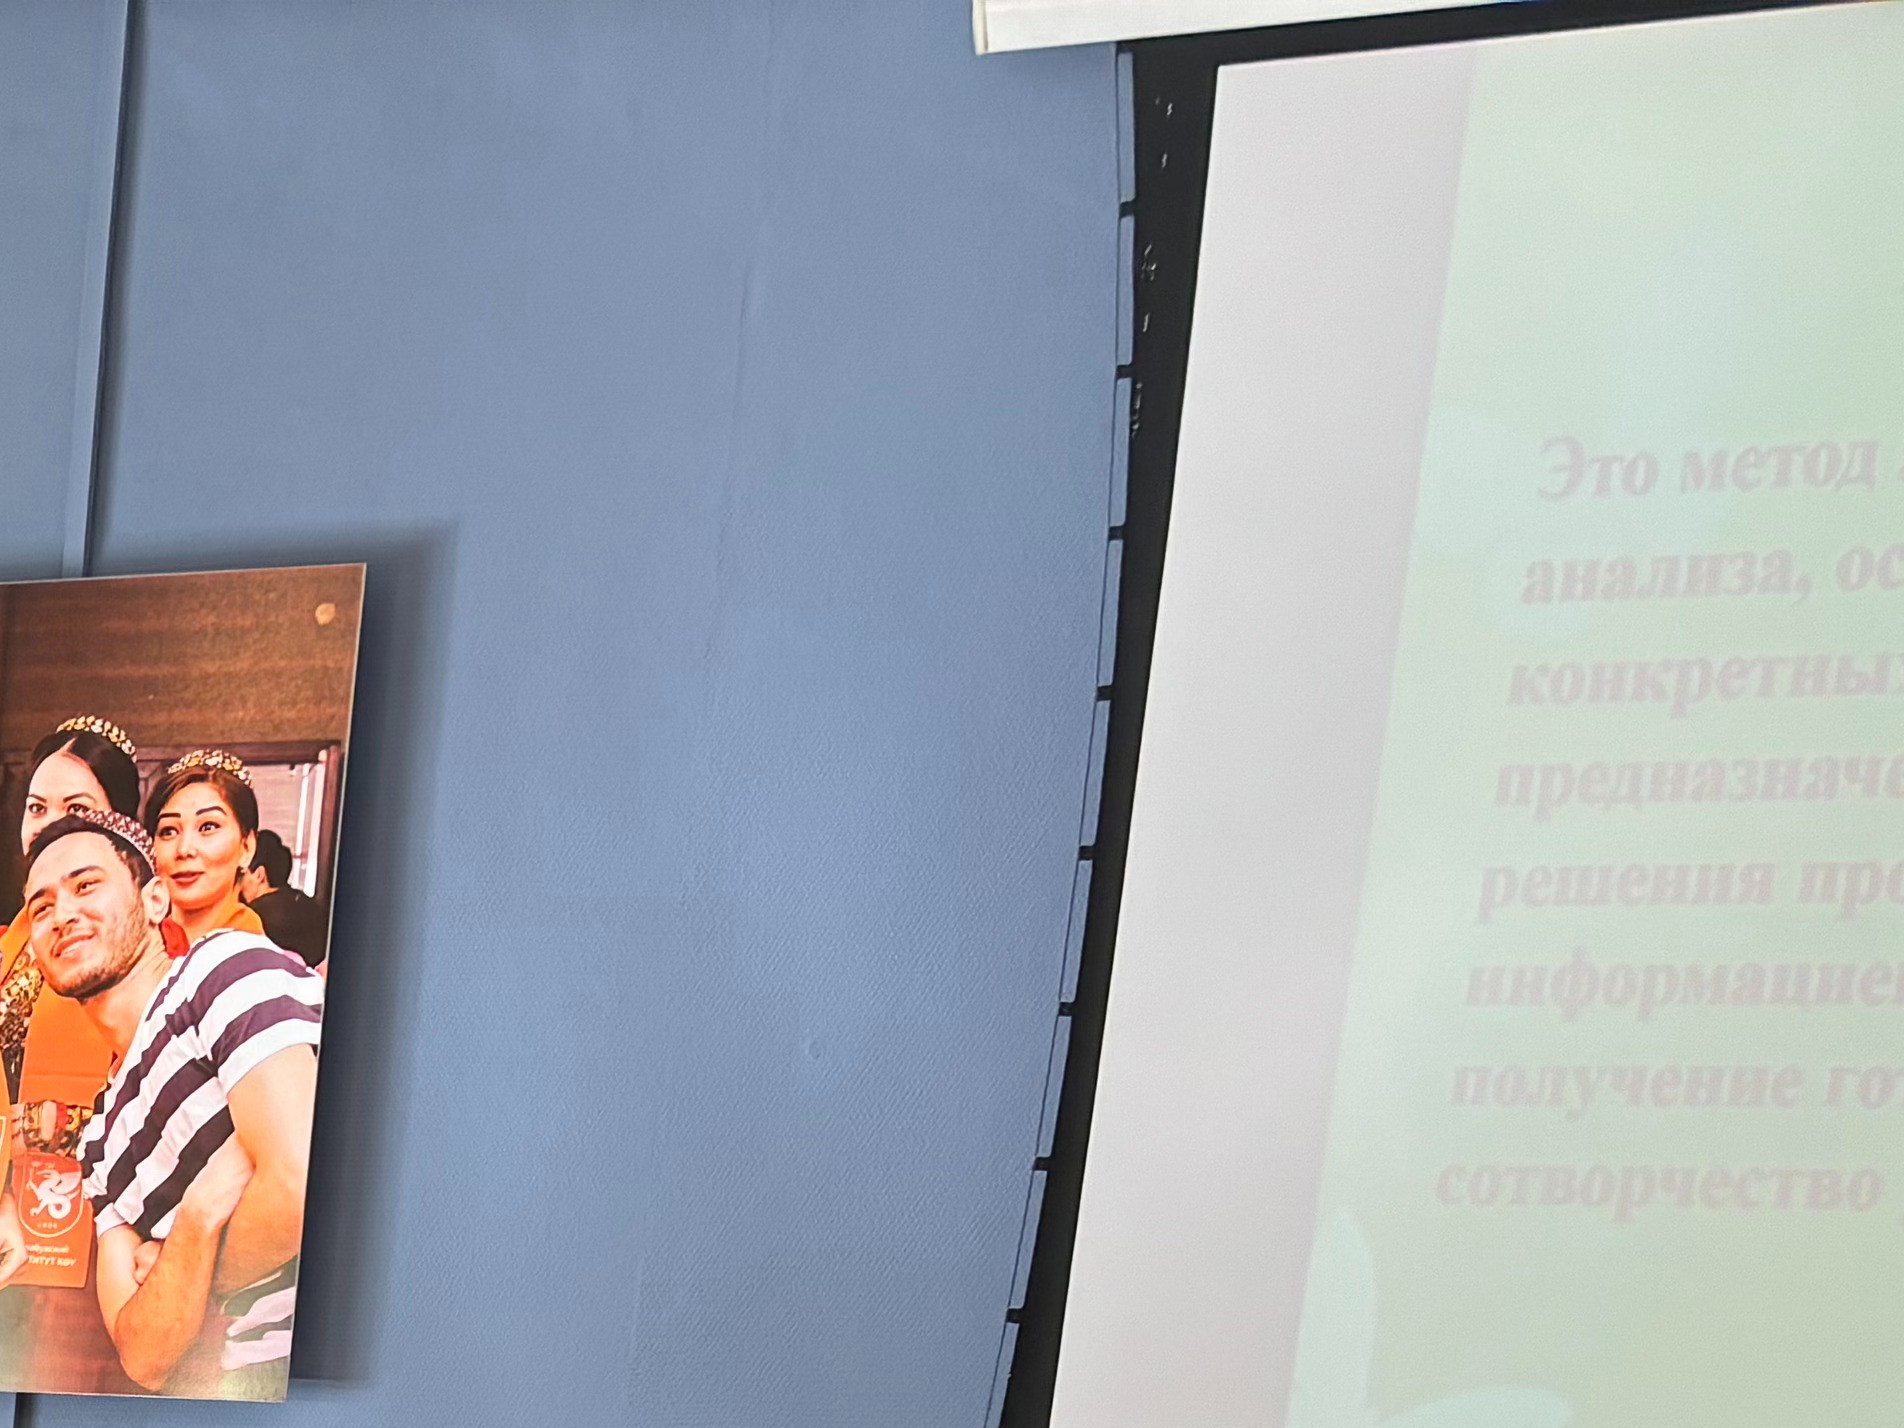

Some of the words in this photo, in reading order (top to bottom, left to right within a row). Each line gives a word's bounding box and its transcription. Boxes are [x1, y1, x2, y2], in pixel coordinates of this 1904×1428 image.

[1536, 434, 1660, 502] Это
[1679, 438, 1881, 493] метод
[1520, 548, 1814, 606] анализа,
[1477, 860, 1778, 925] решения
[1450, 1062, 1805, 1123] получение
[1435, 1162, 1884, 1226] сотворчество
